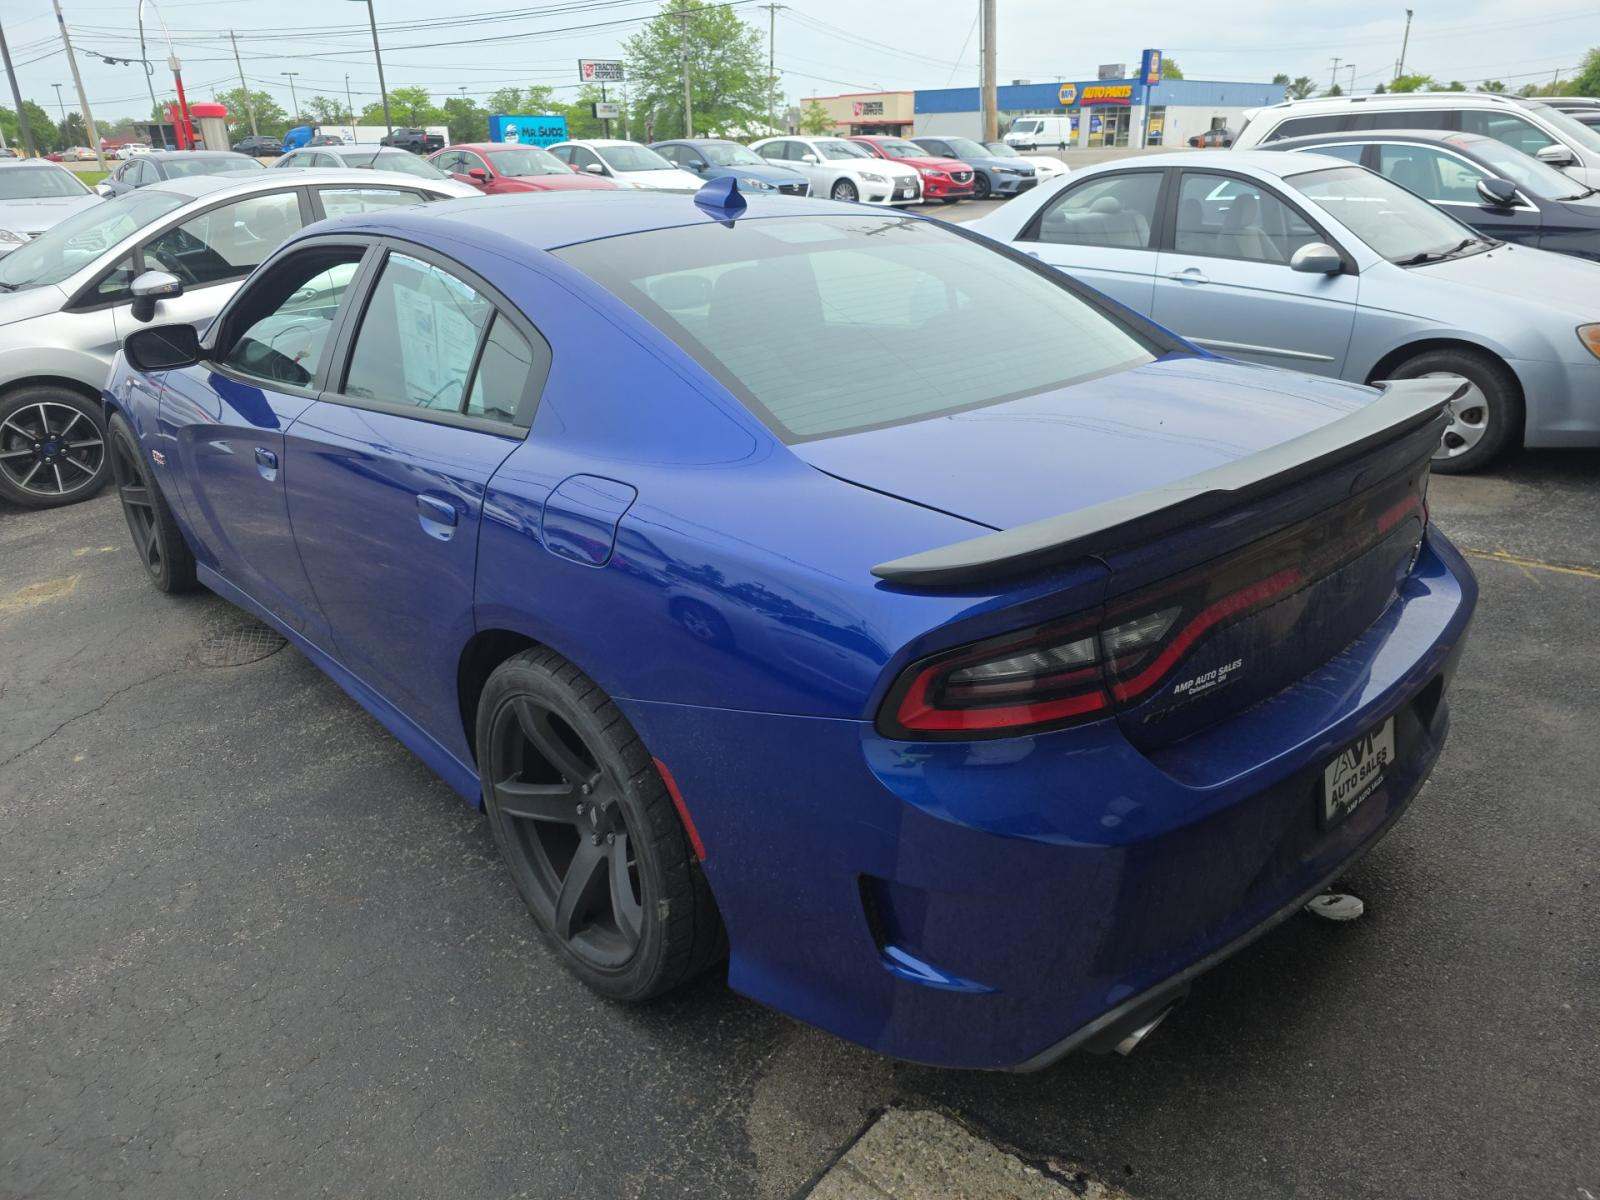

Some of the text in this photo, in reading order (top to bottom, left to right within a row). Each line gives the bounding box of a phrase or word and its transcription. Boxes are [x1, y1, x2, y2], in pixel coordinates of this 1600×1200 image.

[1082, 85, 1132, 98] AUTO PARTS
[1173, 658, 1242, 694] AMP AUTO SALES
[1331, 746, 1387, 807] AUTO SALES
